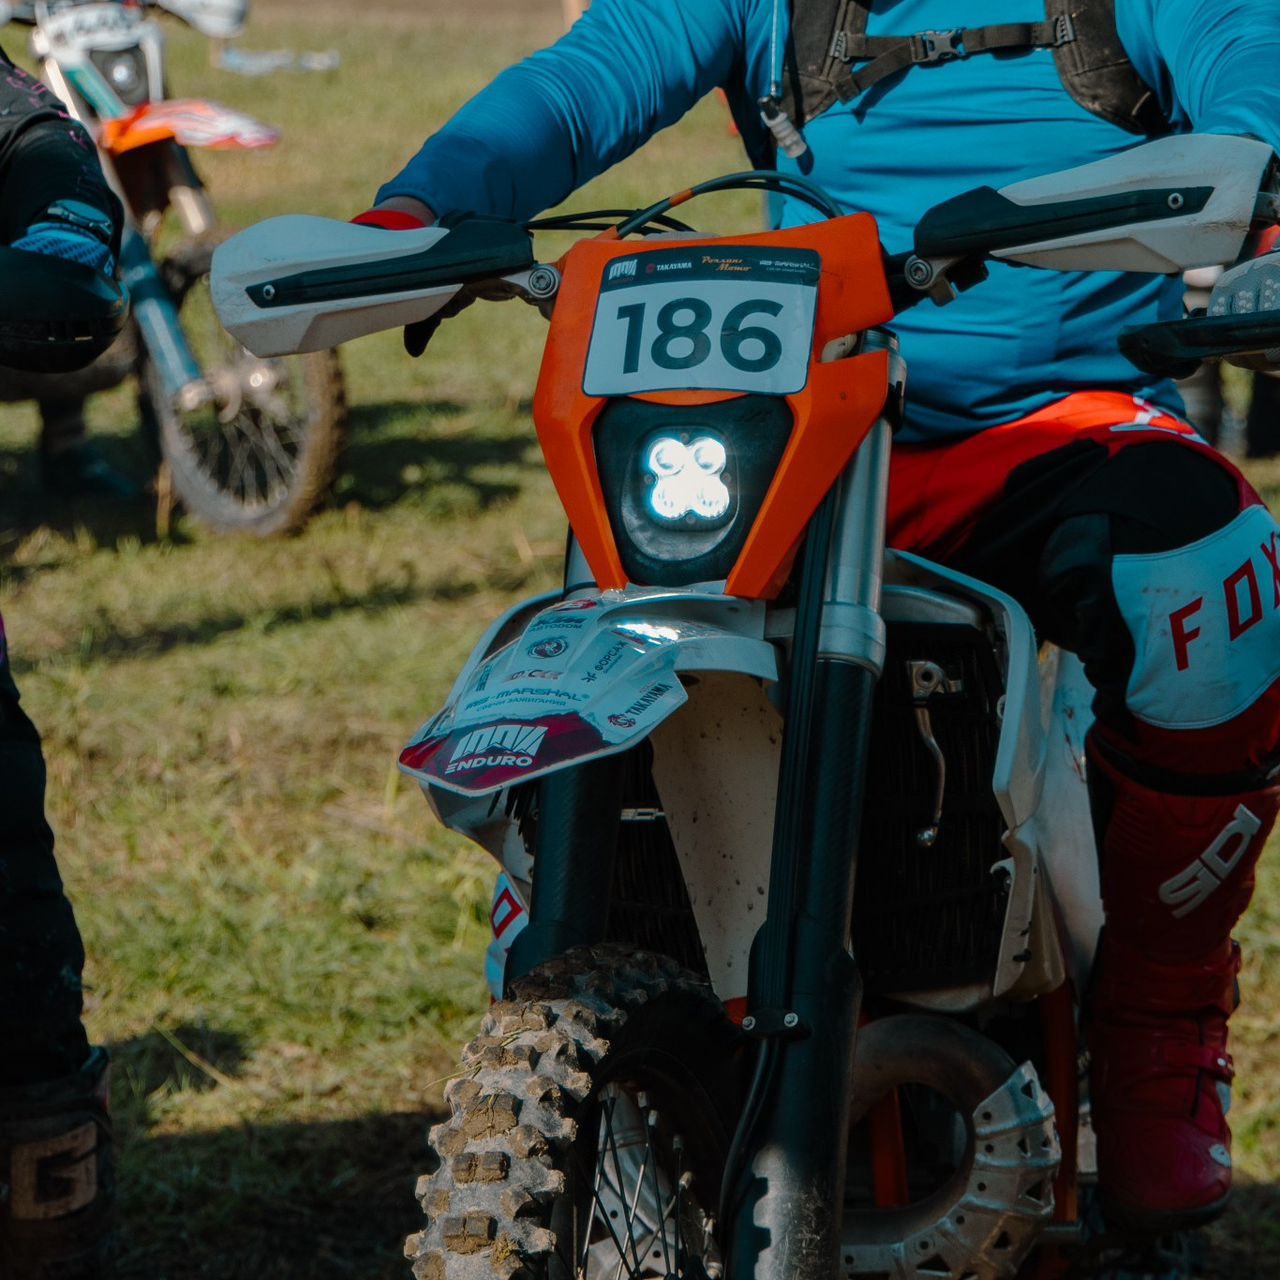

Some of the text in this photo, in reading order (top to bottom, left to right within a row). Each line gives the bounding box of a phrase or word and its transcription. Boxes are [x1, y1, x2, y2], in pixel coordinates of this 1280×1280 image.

[656, 262, 692, 271] TAKAYAMA
[615, 297, 785, 374] 186
[507, 697, 567, 707] ЗАЖИГАНИЯ
[625, 682, 674, 716] TAKAYAMA
[445, 755, 533, 775] ENDURO
